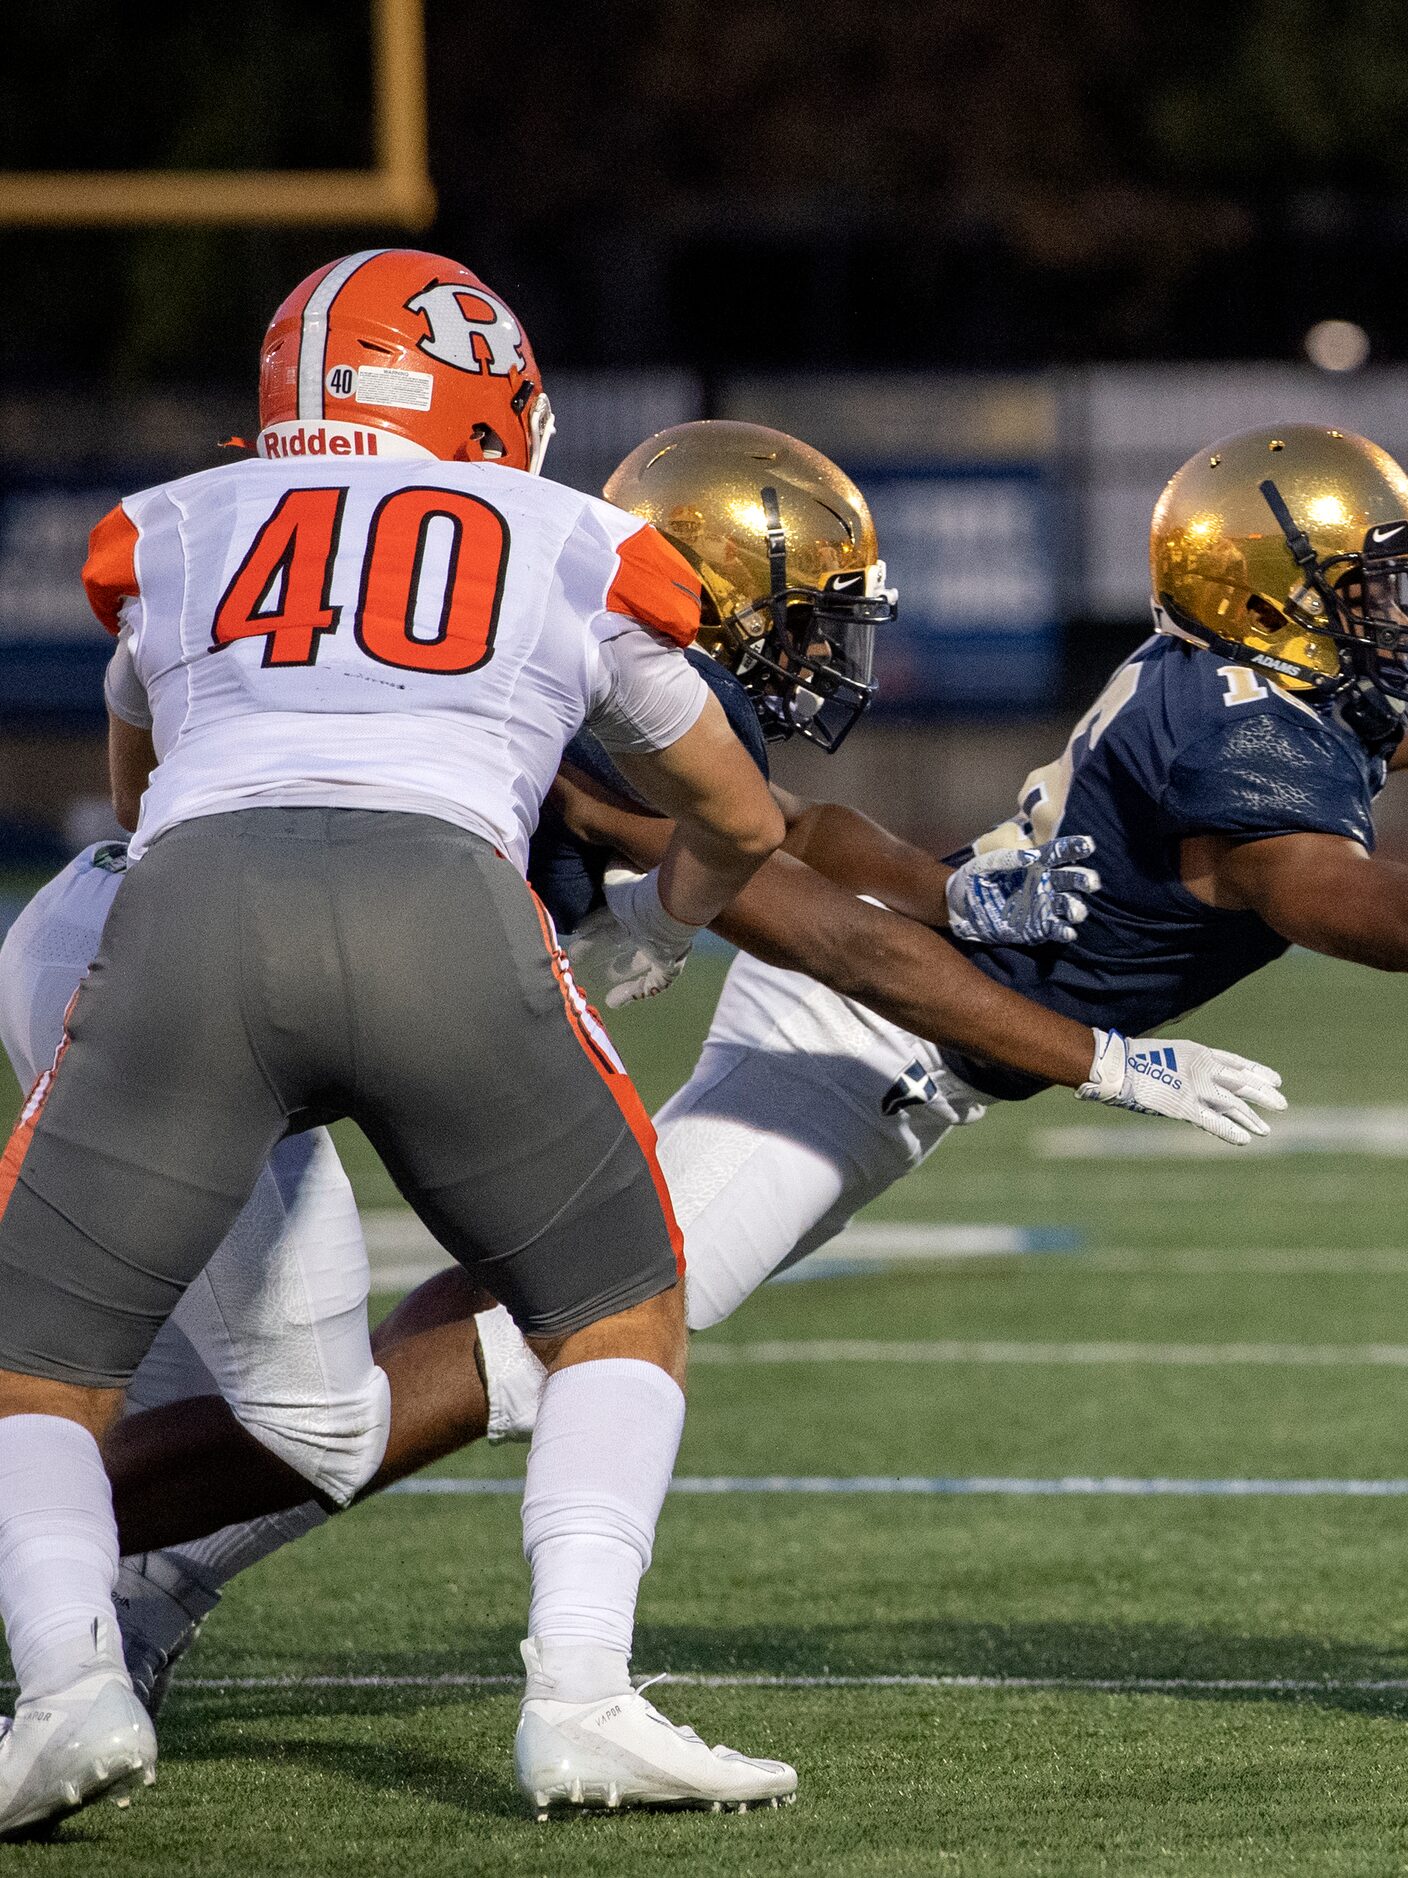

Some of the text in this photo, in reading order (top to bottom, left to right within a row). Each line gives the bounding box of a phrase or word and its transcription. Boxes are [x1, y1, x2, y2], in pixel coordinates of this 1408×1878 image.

[402, 277, 527, 378] R
[330, 368, 353, 394] 40
[263, 428, 378, 460] Riddell
[207, 486, 511, 676] 40
[1250, 653, 1301, 677] ADAMS
[1127, 1056, 1182, 1090] adidas
[594, 1704, 622, 1727] VAPOR
